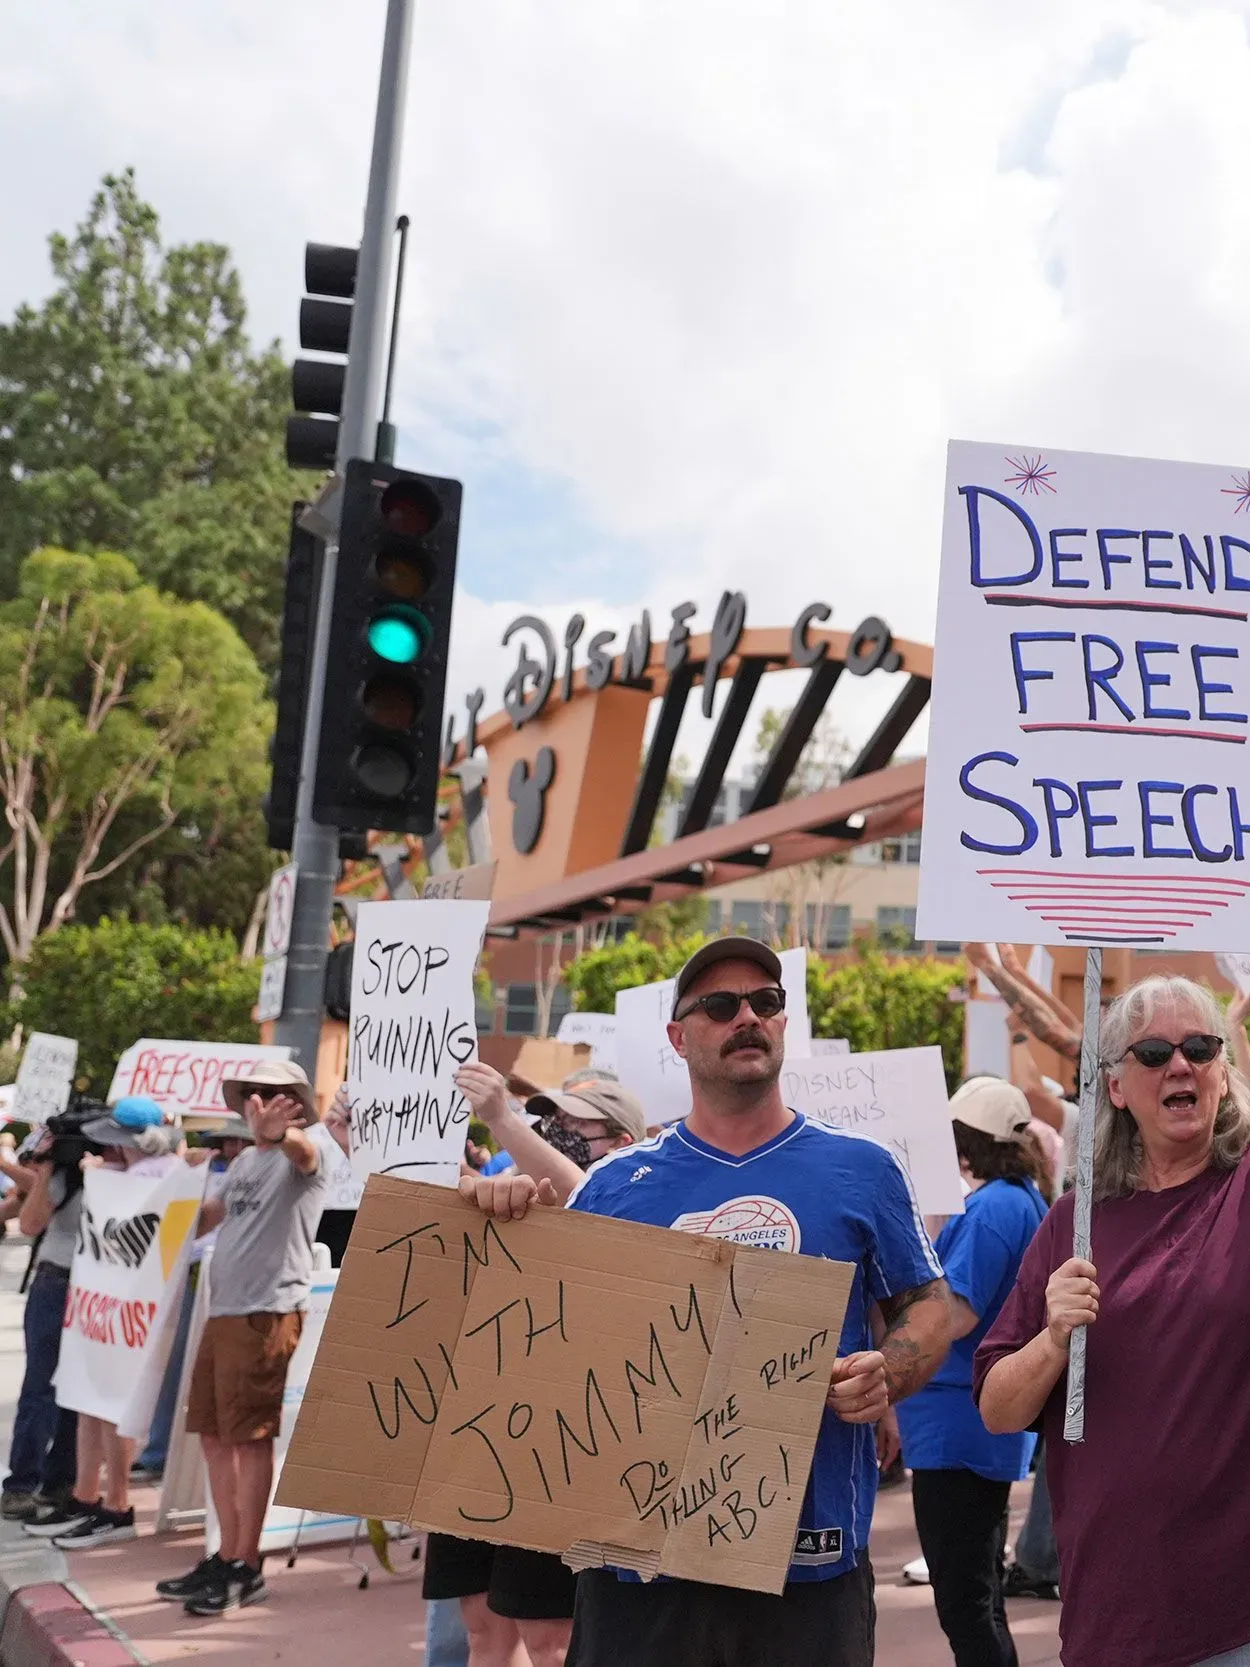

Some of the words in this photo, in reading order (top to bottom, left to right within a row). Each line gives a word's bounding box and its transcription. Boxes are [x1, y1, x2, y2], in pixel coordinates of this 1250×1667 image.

[1010, 631, 1249, 723] FREE
[362, 938, 449, 997] STOP
[352, 1007, 475, 1083] RUINING
[784, 1062, 878, 1103] DISNEY
[351, 1089, 471, 1158] EVERYTHING
[816, 1101, 886, 1128] MEANS
[733, 1228, 787, 1241] ANGELES
[376, 1219, 522, 1328] I'M
[367, 1280, 568, 1439] WITH
[694, 1394, 742, 1444] THE
[759, 1329, 828, 1390] RIGHT
[640, 1453, 746, 1530] THING
[707, 1445, 792, 1547] ABC!
